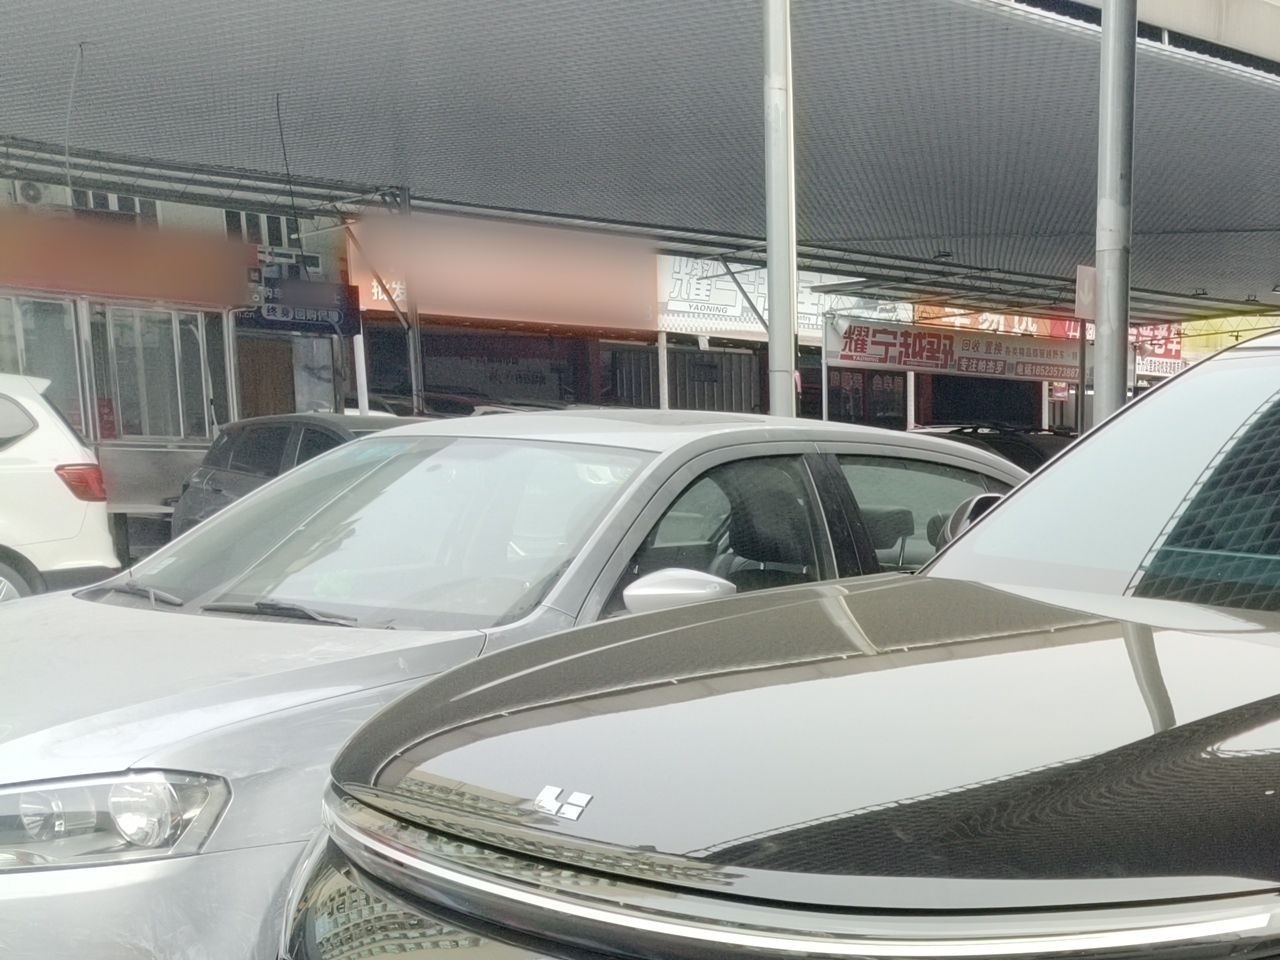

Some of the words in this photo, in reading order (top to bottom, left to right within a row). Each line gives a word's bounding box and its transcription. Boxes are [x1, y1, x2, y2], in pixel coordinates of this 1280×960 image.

[688, 304, 728, 314] YAONING
[841, 325, 957, 369] 耀宁越野
[961, 340, 980, 353] 回收
[959, 359, 1004, 374] 专注帕杰罗
